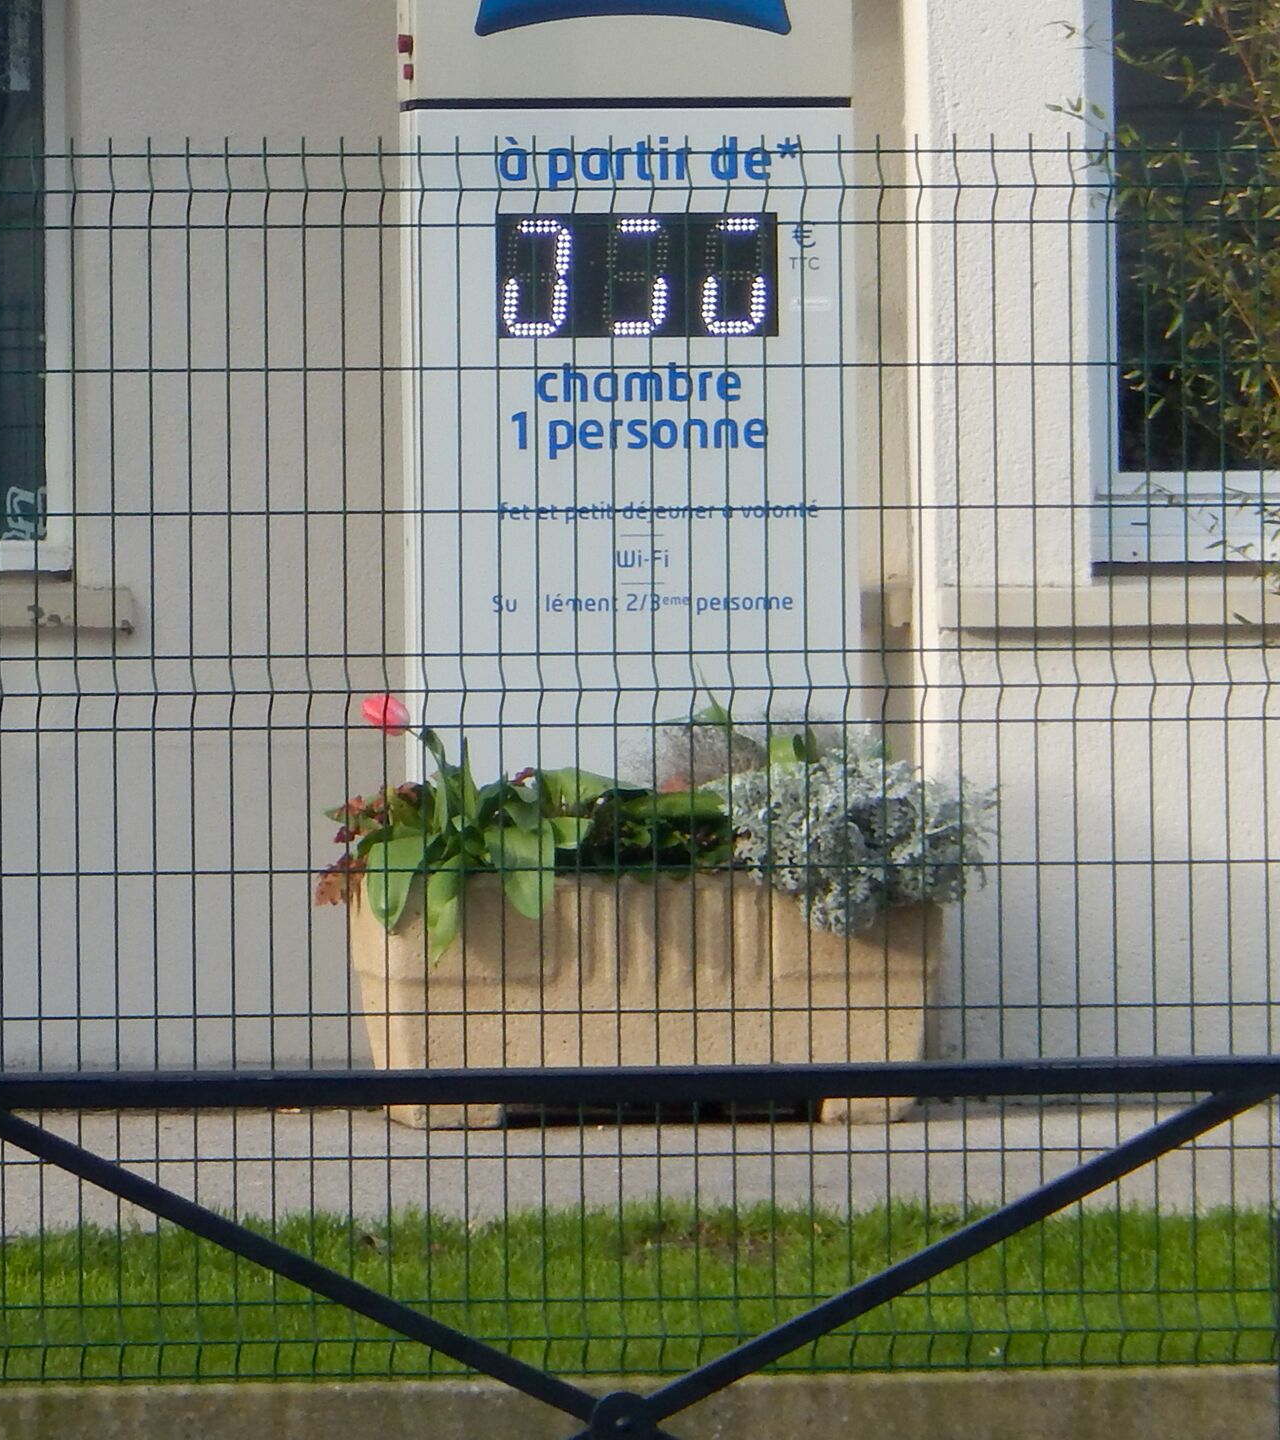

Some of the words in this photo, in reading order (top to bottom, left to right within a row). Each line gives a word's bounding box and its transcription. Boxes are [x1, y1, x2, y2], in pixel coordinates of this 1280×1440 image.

[499, 137, 528, 181] à
[548, 136, 691, 191] partir
[537, 363, 742, 403] chambre
[511, 411, 528, 450] 1
[548, 417, 768, 459] personne
[565, 501, 614, 524] petit
[623, 501, 715, 523] déeuner
[616, 549, 669, 568] Wi-Fi
[696, 595, 794, 615] personne
